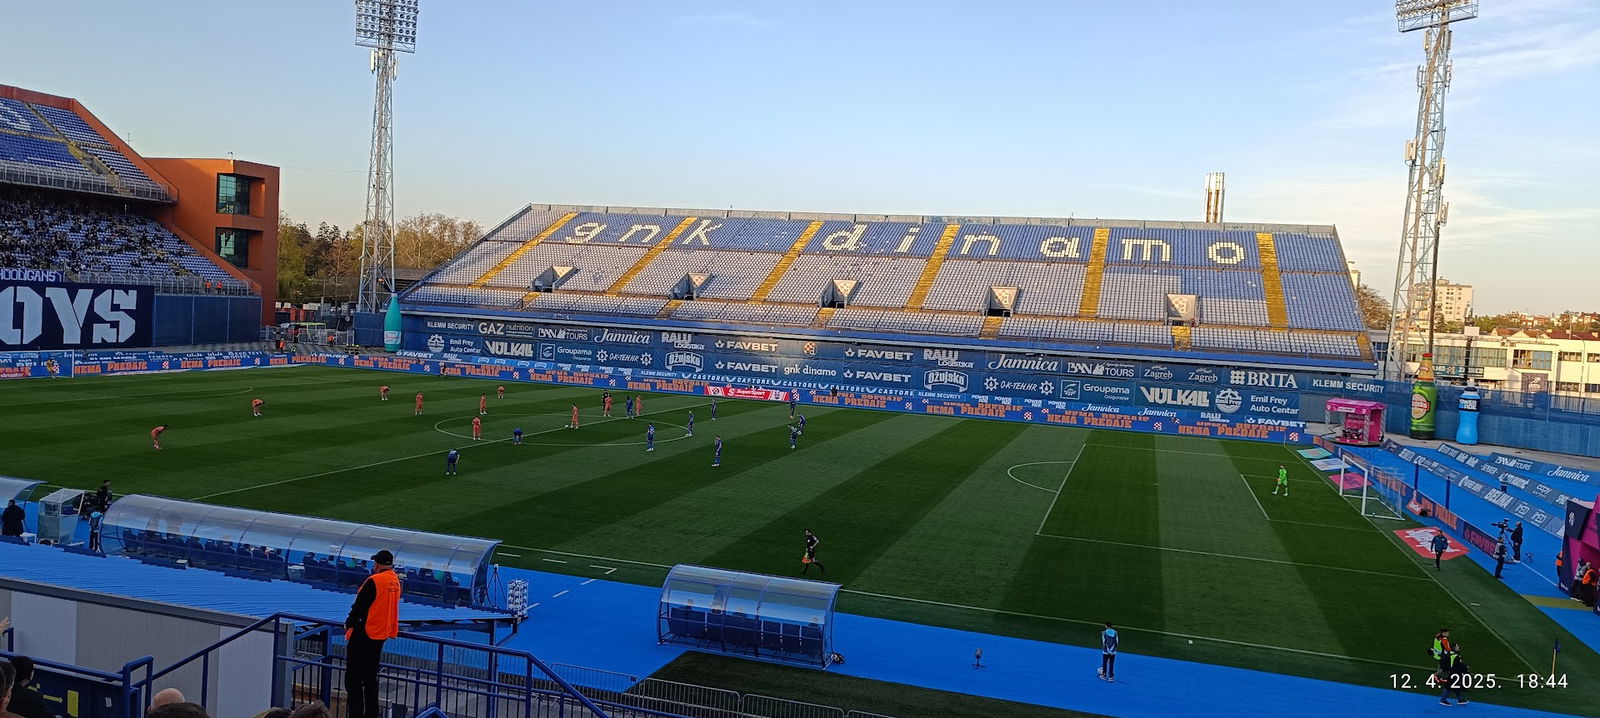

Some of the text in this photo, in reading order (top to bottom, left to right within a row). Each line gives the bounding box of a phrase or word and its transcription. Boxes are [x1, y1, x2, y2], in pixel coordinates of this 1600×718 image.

[565, 218, 1245, 265] gnk dinamo
[448, 323, 475, 331] SECURITY
[478, 322, 504, 335] GAZ
[506, 324, 533, 332] nutrition
[566, 332, 588, 341] TOURS
[594, 328, 650, 344] Jamnica
[557, 346, 592, 356] Groupama
[726, 340, 779, 352] FAVBET
[857, 349, 914, 361] FAVBET
[726, 362, 779, 373] FAVBET
[988, 353, 1059, 372] Jamnica
[784, 364, 837, 377] gnk dinamo
[1105, 367, 1134, 377] TOURS
[1144, 368, 1173, 380] Zagreb
[692, 374, 725, 382] CASTORE
[856, 370, 912, 383] FAVBET
[1188, 372, 1218, 383] Zagreb
[1247, 371, 1298, 389] BRITA
[783, 380, 817, 388] CASTORE
[1083, 383, 1130, 395] Groupama
[1312, 379, 1384, 394] KLEMM SECURITY
[878, 388, 914, 397] CASTORE
[1251, 395, 1288, 406] Emil Frey
[1082, 403, 1120, 413] Jamnica
[1138, 407, 1177, 417] Jamnica
[1273, 406, 1299, 414] Centar
[1257, 418, 1306, 428] FAVBET
[1547, 465, 1590, 482] Jamnica
